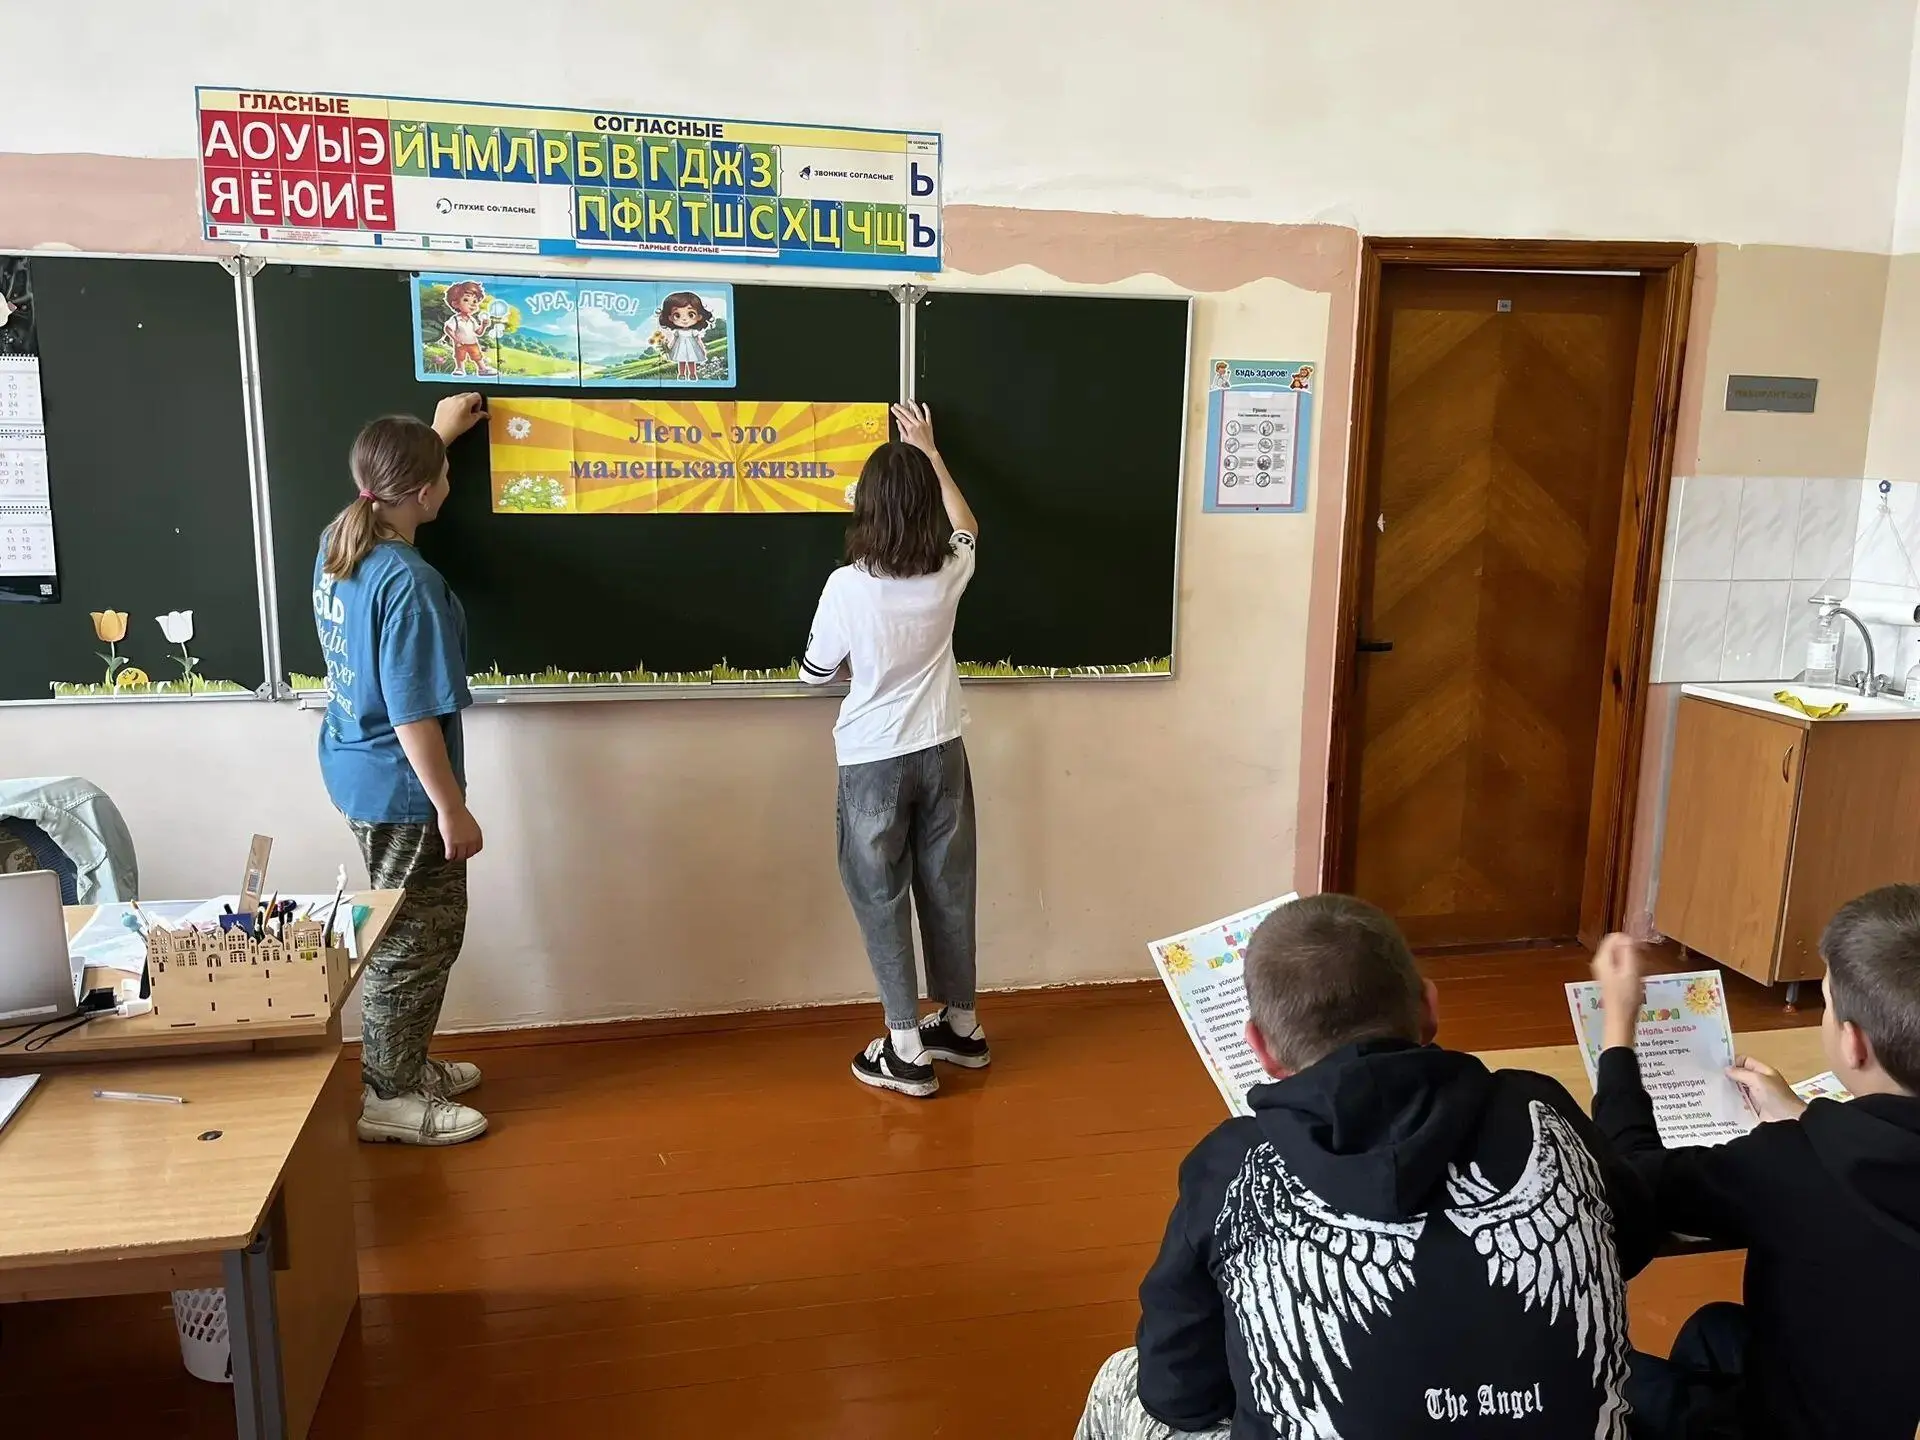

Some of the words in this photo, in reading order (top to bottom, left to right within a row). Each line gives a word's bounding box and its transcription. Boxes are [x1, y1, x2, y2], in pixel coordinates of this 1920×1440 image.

[239, 94, 350, 114] ГЛАСНЫЕ
[594, 116, 723, 138] СОГЛАСНЫЕ
[814, 170, 848, 178] ЗВОНКИЕ
[849, 172, 894, 181] СОГЛАСНЫЕ
[910, 162, 934, 197] Ь
[453, 203, 485, 212] ГЛУХИЕ
[908, 213, 936, 248] Ъ
[525, 290, 574, 315] УРА,
[577, 290, 640, 316] ЛЕТО!
[1235, 369, 1255, 378] БУДЬ
[629, 419, 702, 444] Лето
[731, 425, 777, 444] это
[569, 460, 736, 479] маленькая
[744, 460, 835, 479] жизнь
[1192, 984, 1216, 995] создать
[1196, 995, 1211, 1005] прав
[1201, 995, 1243, 1014] полноценный
[1205, 1007, 1245, 1024] организовать
[1209, 1019, 1243, 1033] обеспечить
[1659, 1078, 1706, 1090] территории
[1657, 1113, 1683, 1122] Закон
[1684, 1111, 1712, 1120] зелени
[1424, 1387, 1469, 1422] The
[1477, 1382, 1544, 1419] Angel
